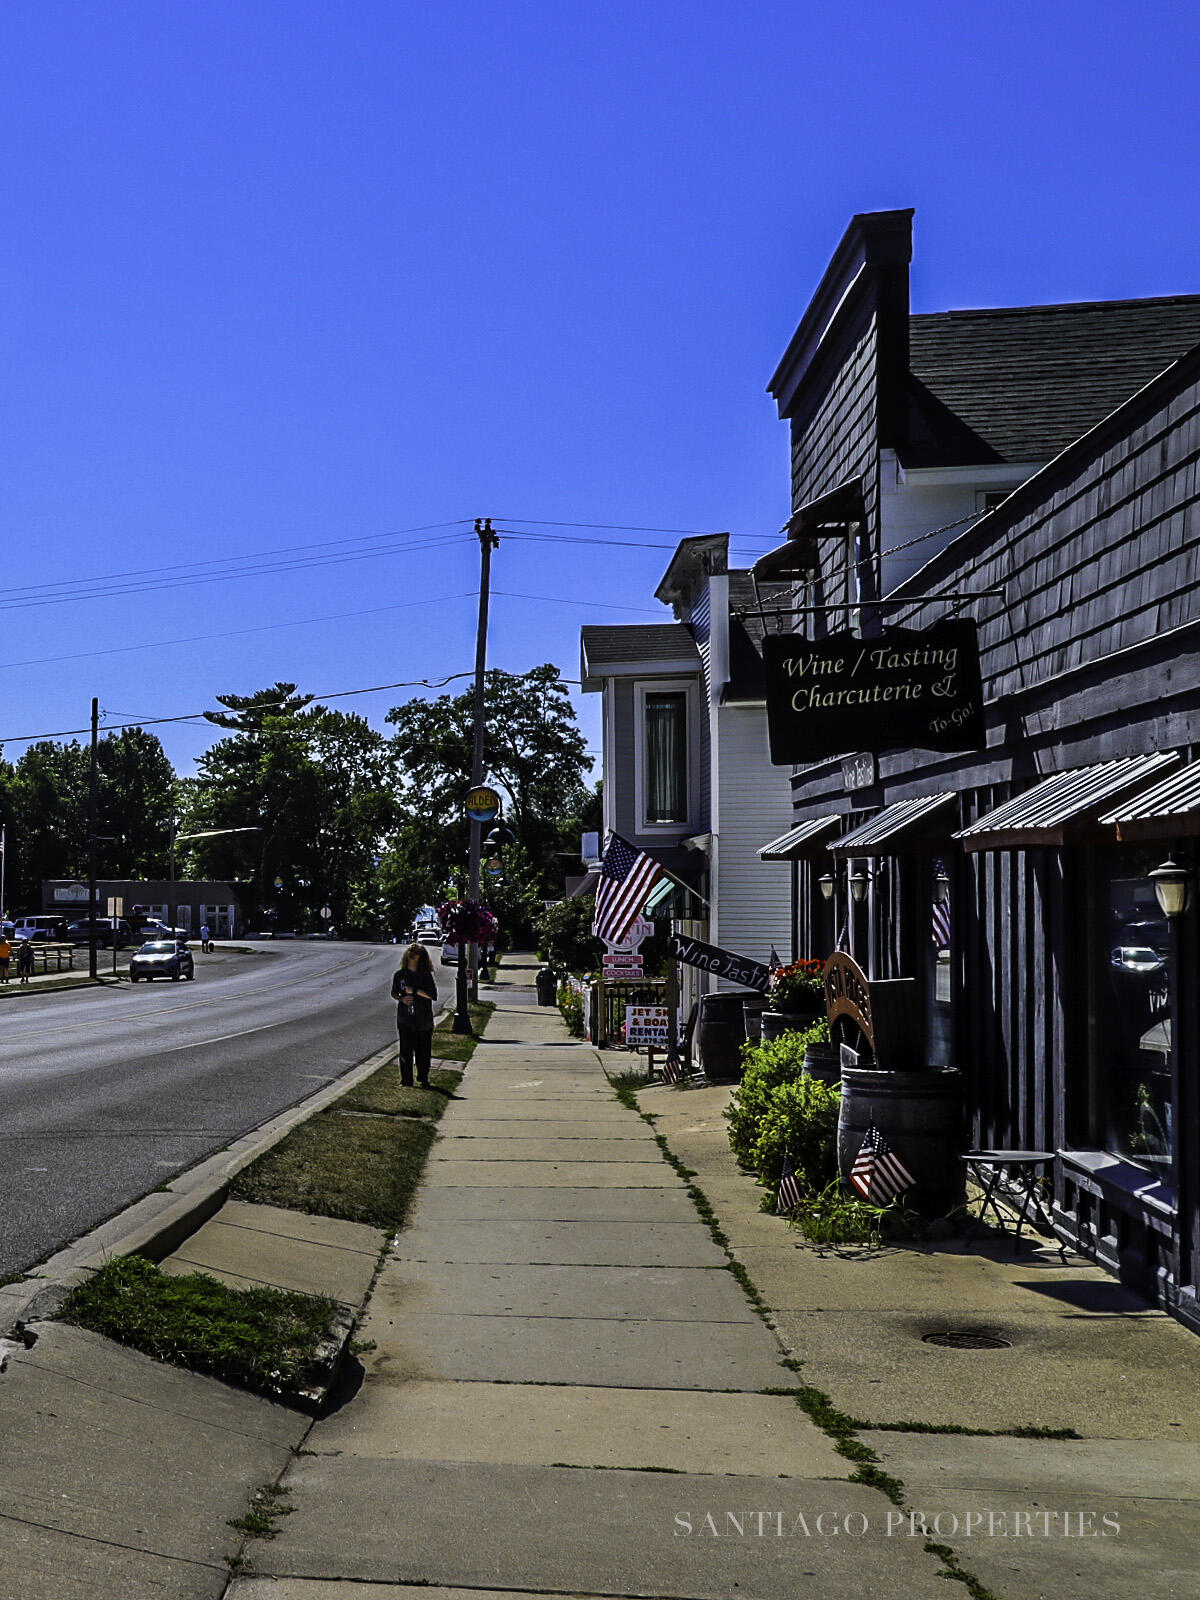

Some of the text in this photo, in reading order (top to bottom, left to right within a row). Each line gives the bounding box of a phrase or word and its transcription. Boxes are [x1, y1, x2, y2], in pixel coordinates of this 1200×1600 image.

[782, 643, 959, 679] Wine / Tasting
[791, 672, 958, 712] Charcuterie &
[928, 702, 976, 735] To-Go!
[467, 795, 498, 806] ALDEN
[674, 938, 721, 971] Wine
[606, 970, 641, 978] COCKTAILS
[631, 1008, 670, 1017] JET SK
[632, 1017, 669, 1027] & BOA
